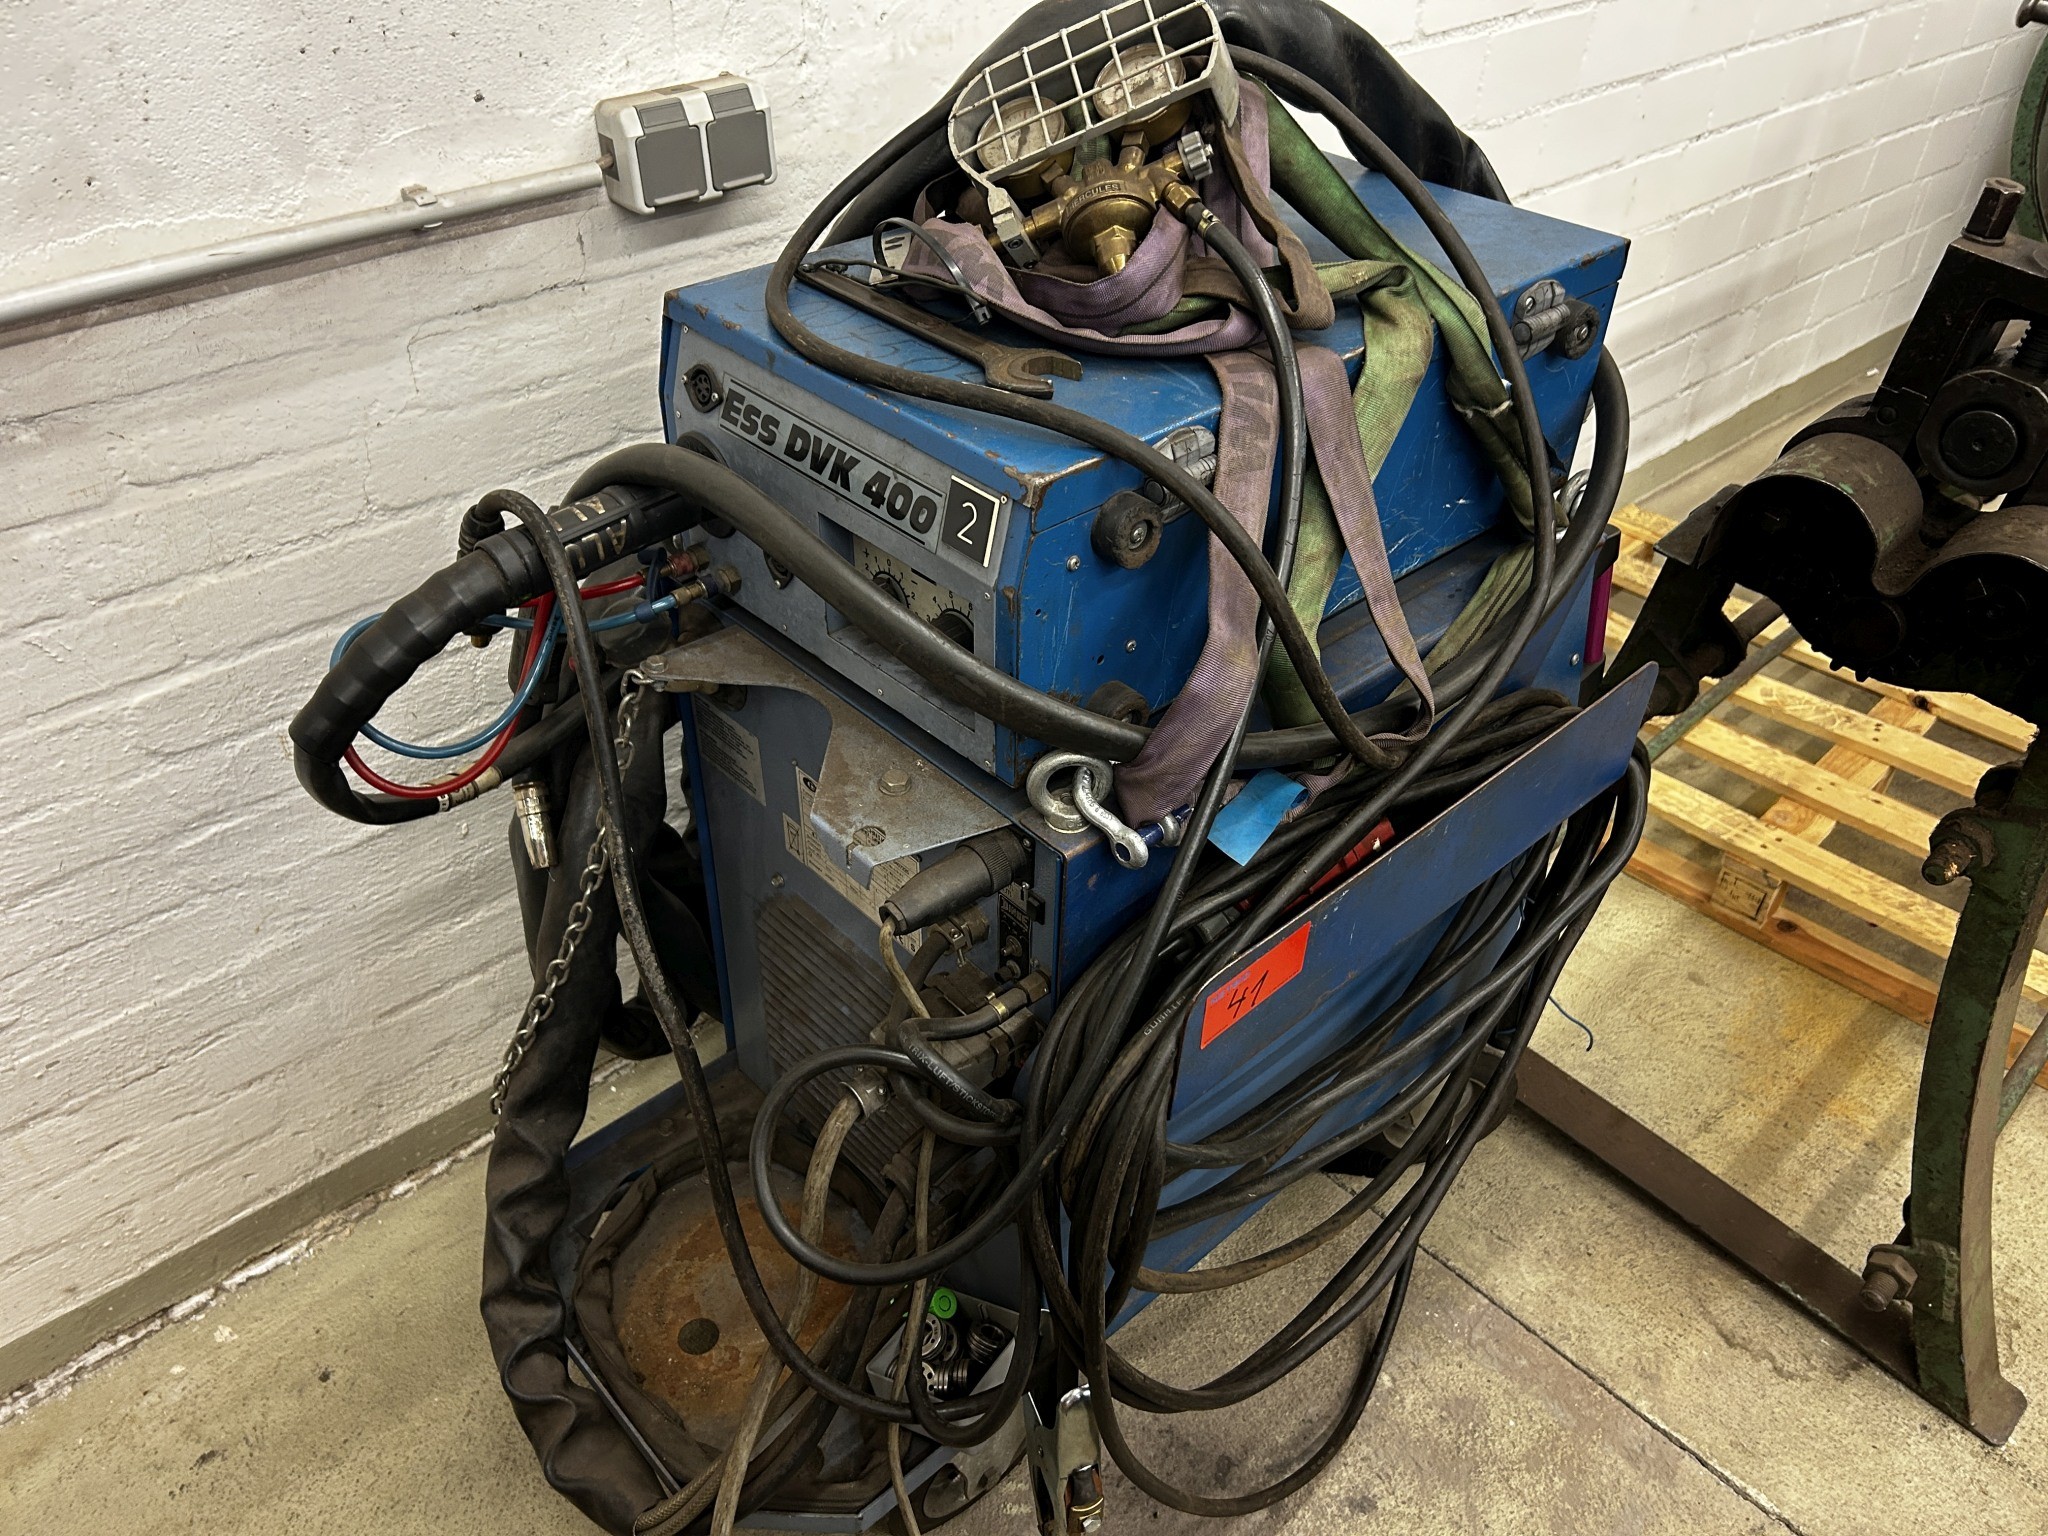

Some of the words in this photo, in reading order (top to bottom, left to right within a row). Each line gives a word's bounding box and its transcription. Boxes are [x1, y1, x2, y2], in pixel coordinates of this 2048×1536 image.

[721, 388, 781, 446] ESS
[783, 423, 861, 492] DVK
[861, 470, 938, 535] 400
[956, 501, 978, 545] 2
[1227, 970, 1269, 1019] 41
